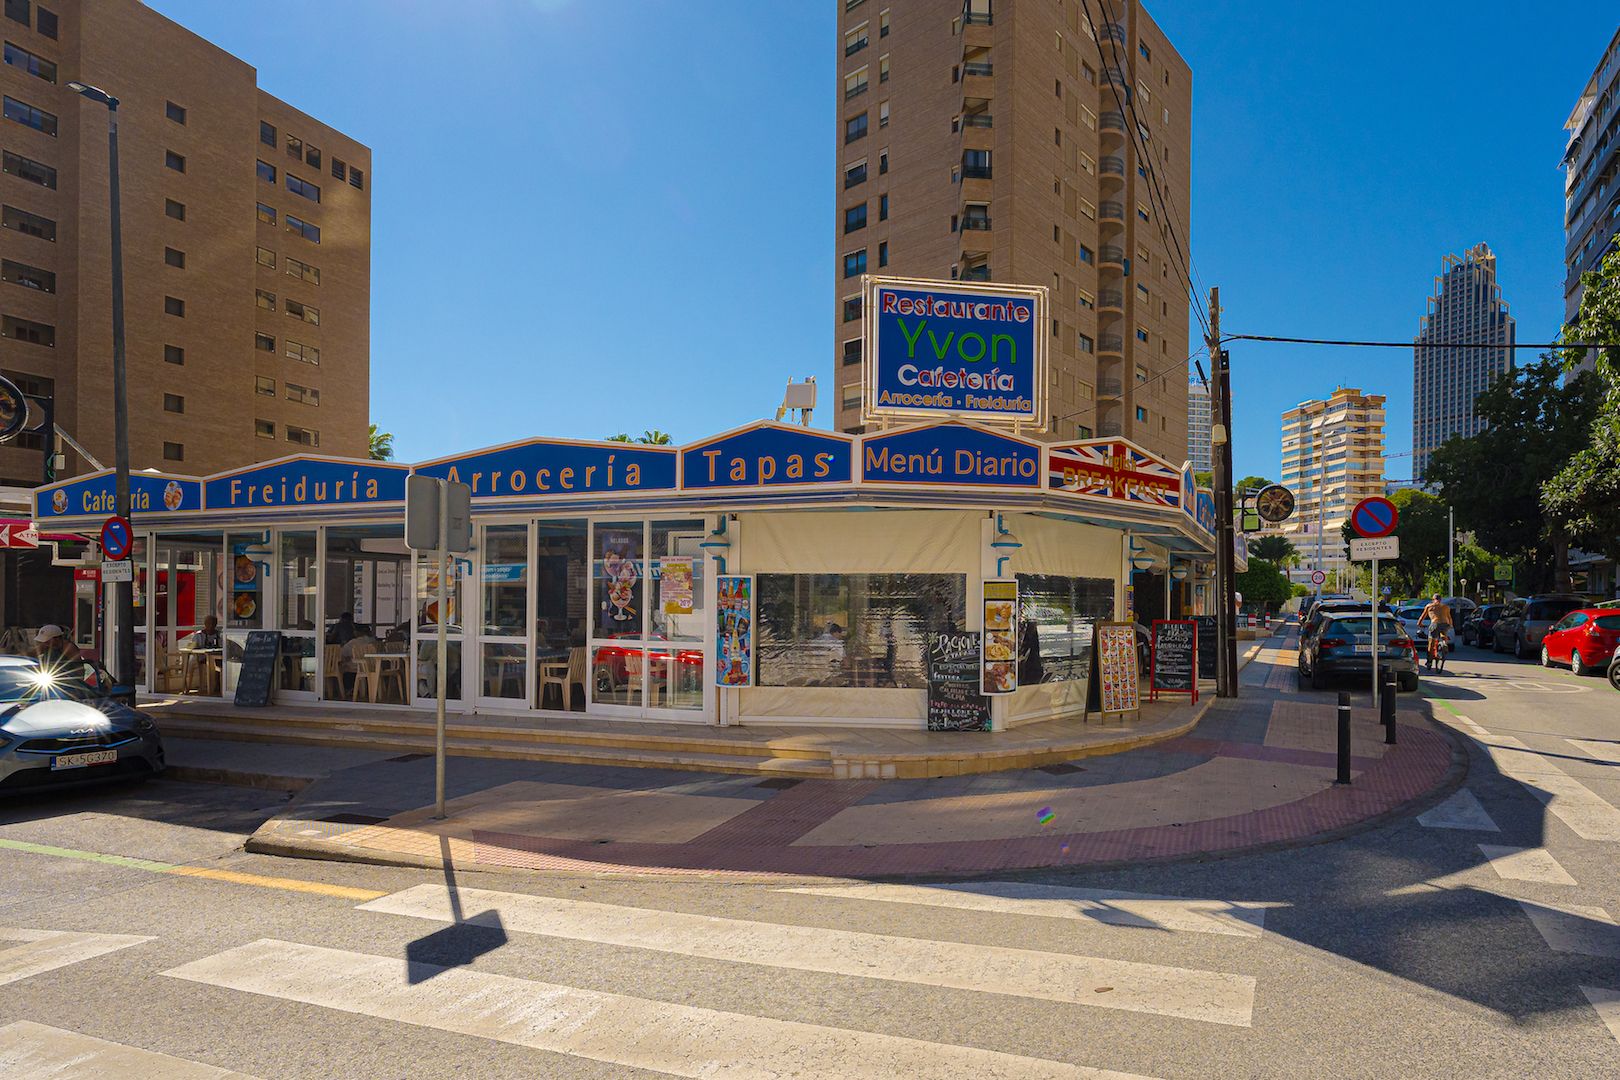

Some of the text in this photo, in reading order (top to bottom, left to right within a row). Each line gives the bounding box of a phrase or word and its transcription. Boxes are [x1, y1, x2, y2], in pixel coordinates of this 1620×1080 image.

[883, 291, 1031, 323] Restaurante
[897, 318, 1017, 364] Yvon
[897, 364, 1014, 391] Cafetería
[878, 389, 1032, 412] Arrocería Freiduría
[447, 455, 640, 492] Arrocería
[703, 450, 830, 485] Tapas
[865, 447, 1036, 478] Menú Diario
[1102, 449, 1137, 473] English
[230, 471, 378, 505] Freiduría
[1063, 466, 1168, 502] BREAKFAST
[82, 488, 150, 513] Cafería
